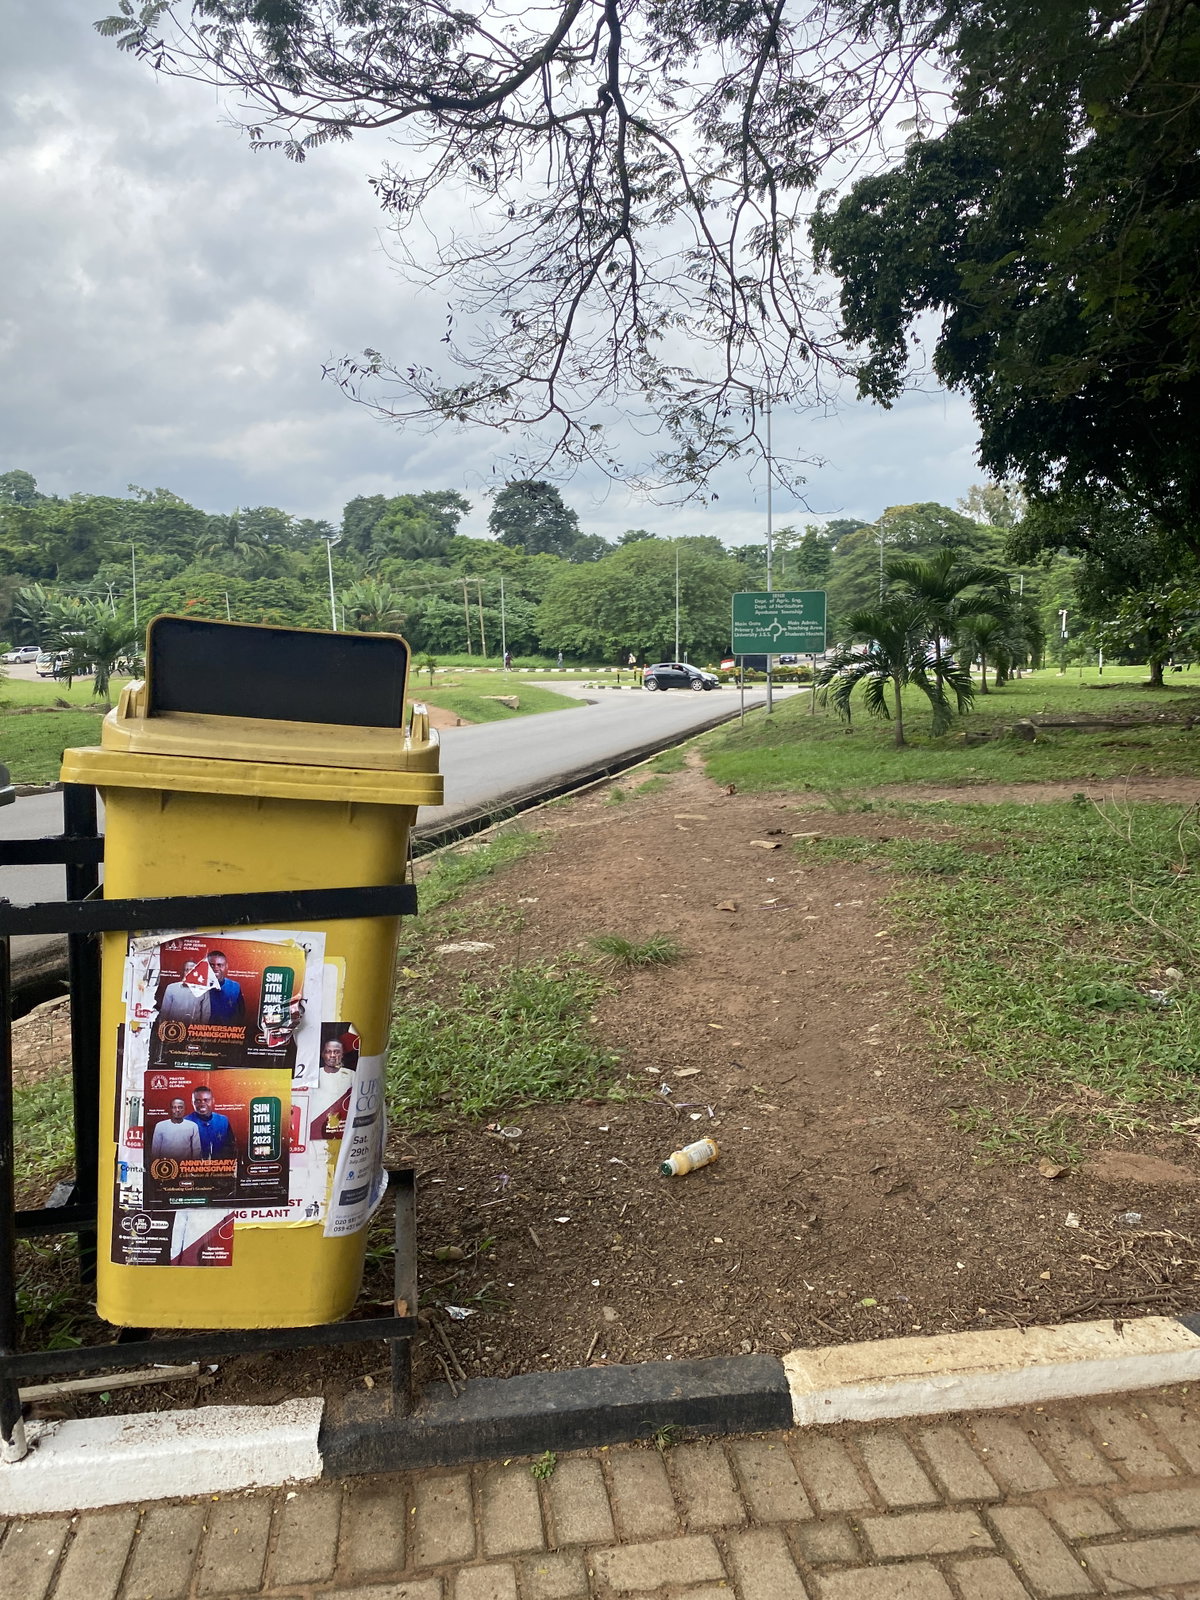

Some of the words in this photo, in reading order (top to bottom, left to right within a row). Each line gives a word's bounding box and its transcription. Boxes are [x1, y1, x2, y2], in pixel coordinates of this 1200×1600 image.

[266, 972, 283, 982] SUN
[264, 984, 282, 993] 11TH
[264, 994, 282, 1003] JUNE
[168, 1026, 176, 1036] 6
[188, 1024, 246, 1033] ANNIVERSARY/
[188, 1030, 245, 1039] THANKSGIVING
[295, 1064, 305, 1078] 2
[253, 1104, 269, 1113] SUN
[253, 1114, 270, 1123] 11TH
[253, 1125, 271, 1134] JUNE
[253, 1136, 271, 1145] 2023
[160, 1163, 169, 1174] 6
[251, 1209, 290, 1218] PLANT
